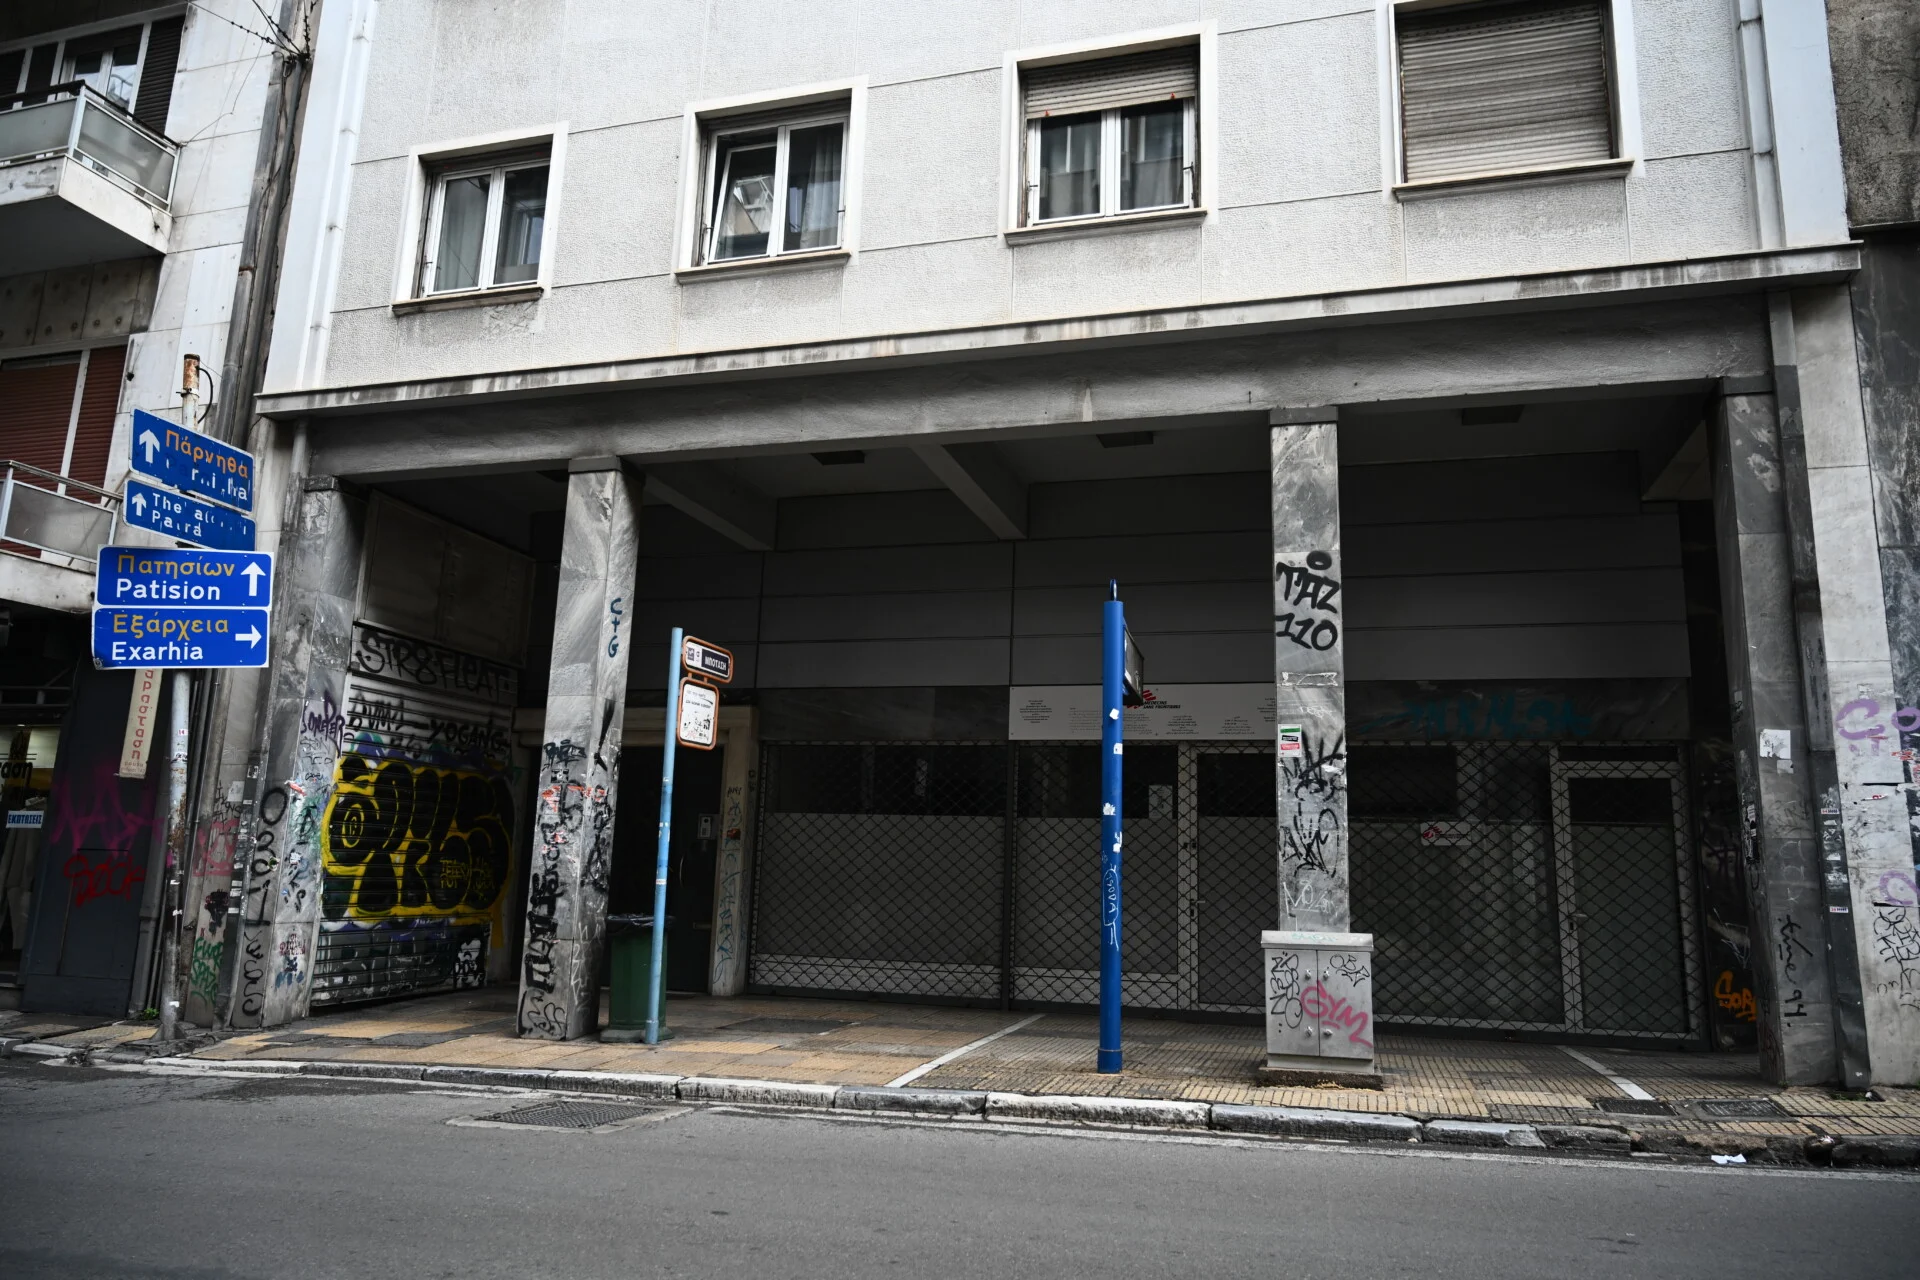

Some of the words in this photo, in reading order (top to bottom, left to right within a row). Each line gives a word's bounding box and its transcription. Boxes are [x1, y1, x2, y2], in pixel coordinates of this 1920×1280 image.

[165, 429, 248, 478] Πάρνηθα
[117, 555, 235, 579] Πατησίων
[116, 579, 220, 600] Patision
[113, 611, 229, 641] Εξάρχεια
[112, 641, 203, 661] Exarhia
[1300, 979, 1373, 1049] GYM
